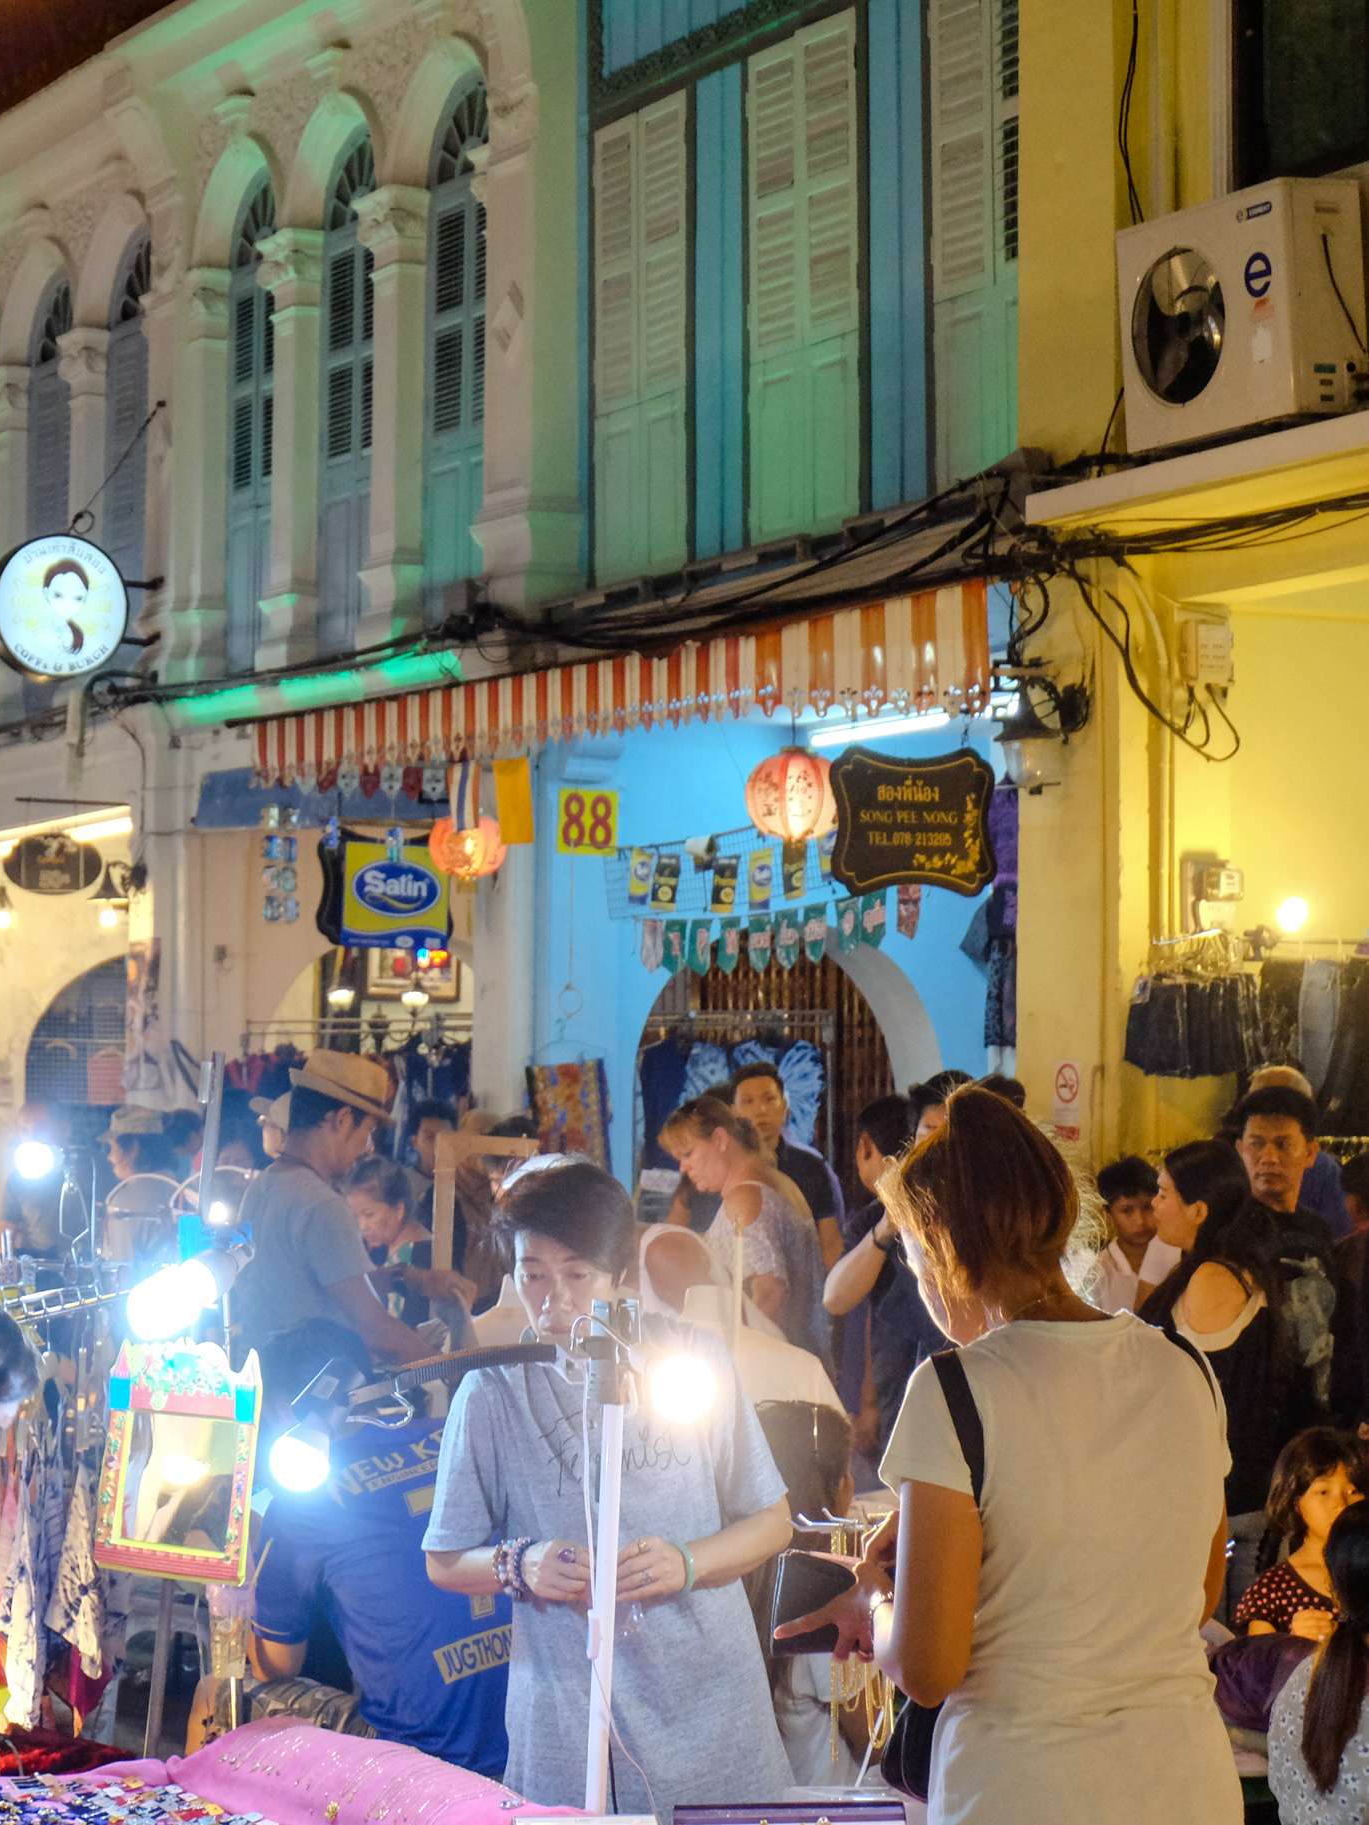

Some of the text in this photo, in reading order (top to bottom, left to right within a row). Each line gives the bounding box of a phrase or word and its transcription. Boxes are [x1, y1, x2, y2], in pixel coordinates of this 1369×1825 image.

[562, 792, 612, 850] 88
[859, 809, 958, 825] SONG PEE NONG
[363, 869, 427, 898] Satin
